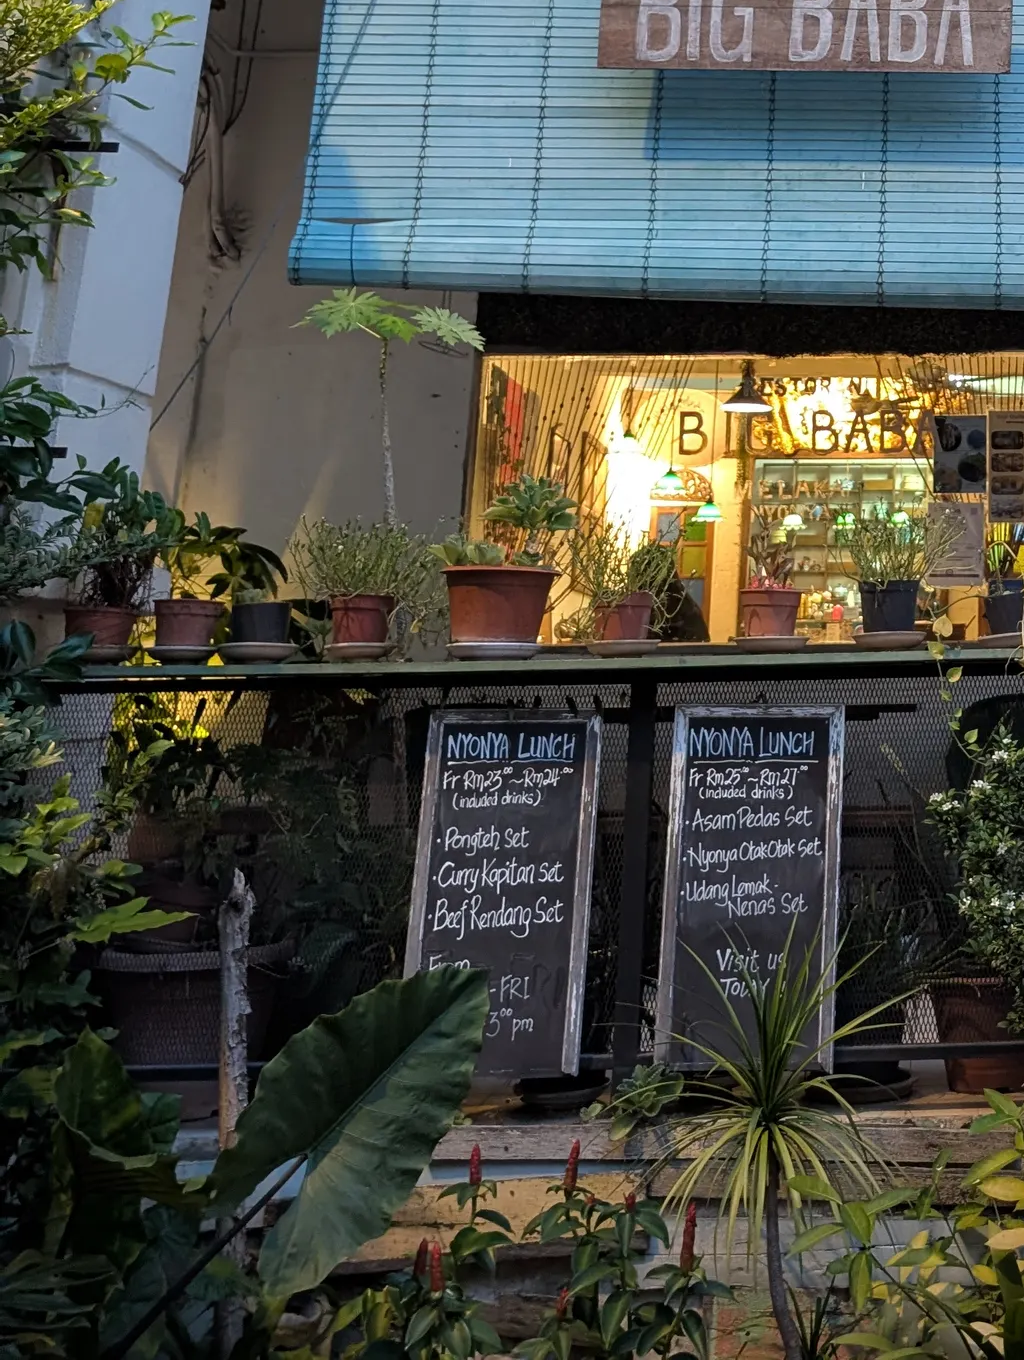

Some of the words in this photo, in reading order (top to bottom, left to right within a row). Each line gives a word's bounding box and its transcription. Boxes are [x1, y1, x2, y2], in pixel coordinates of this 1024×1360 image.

[810, 408, 936, 456] BABA
[447, 732, 509, 759] NYONYA
[517, 732, 576, 759] LUNCH
[689, 726, 754, 758] NYONYA
[759, 726, 815, 757] LUNCH
[443, 770, 461, 789] Fr
[689, 768, 704, 787] Fr
[452, 792, 498, 810] (included
[501, 789, 542, 807] drinks)
[692, 808, 736, 832] Asam
[736, 805, 781, 829] Pedas
[784, 805, 813, 828] Set
[444, 825, 500, 856] Pongteh
[504, 826, 530, 848] Set
[687, 842, 738, 873] Nyonya
[797, 837, 823, 858] Set
[437, 861, 479, 894] Curry
[481, 857, 534, 894] Kapitan
[538, 861, 564, 883] Set
[685, 879, 729, 907] Udang
[731, 873, 773, 898] Lemak
[432, 898, 469, 940] Beef
[470, 895, 532, 938] Rendang
[533, 896, 564, 923] Set
[728, 897, 775, 919] Nenas
[781, 893, 808, 914] Set
[716, 948, 760, 973] Visit
[500, 974, 530, 1003] FRI
[512, 1018, 534, 1041] pm
